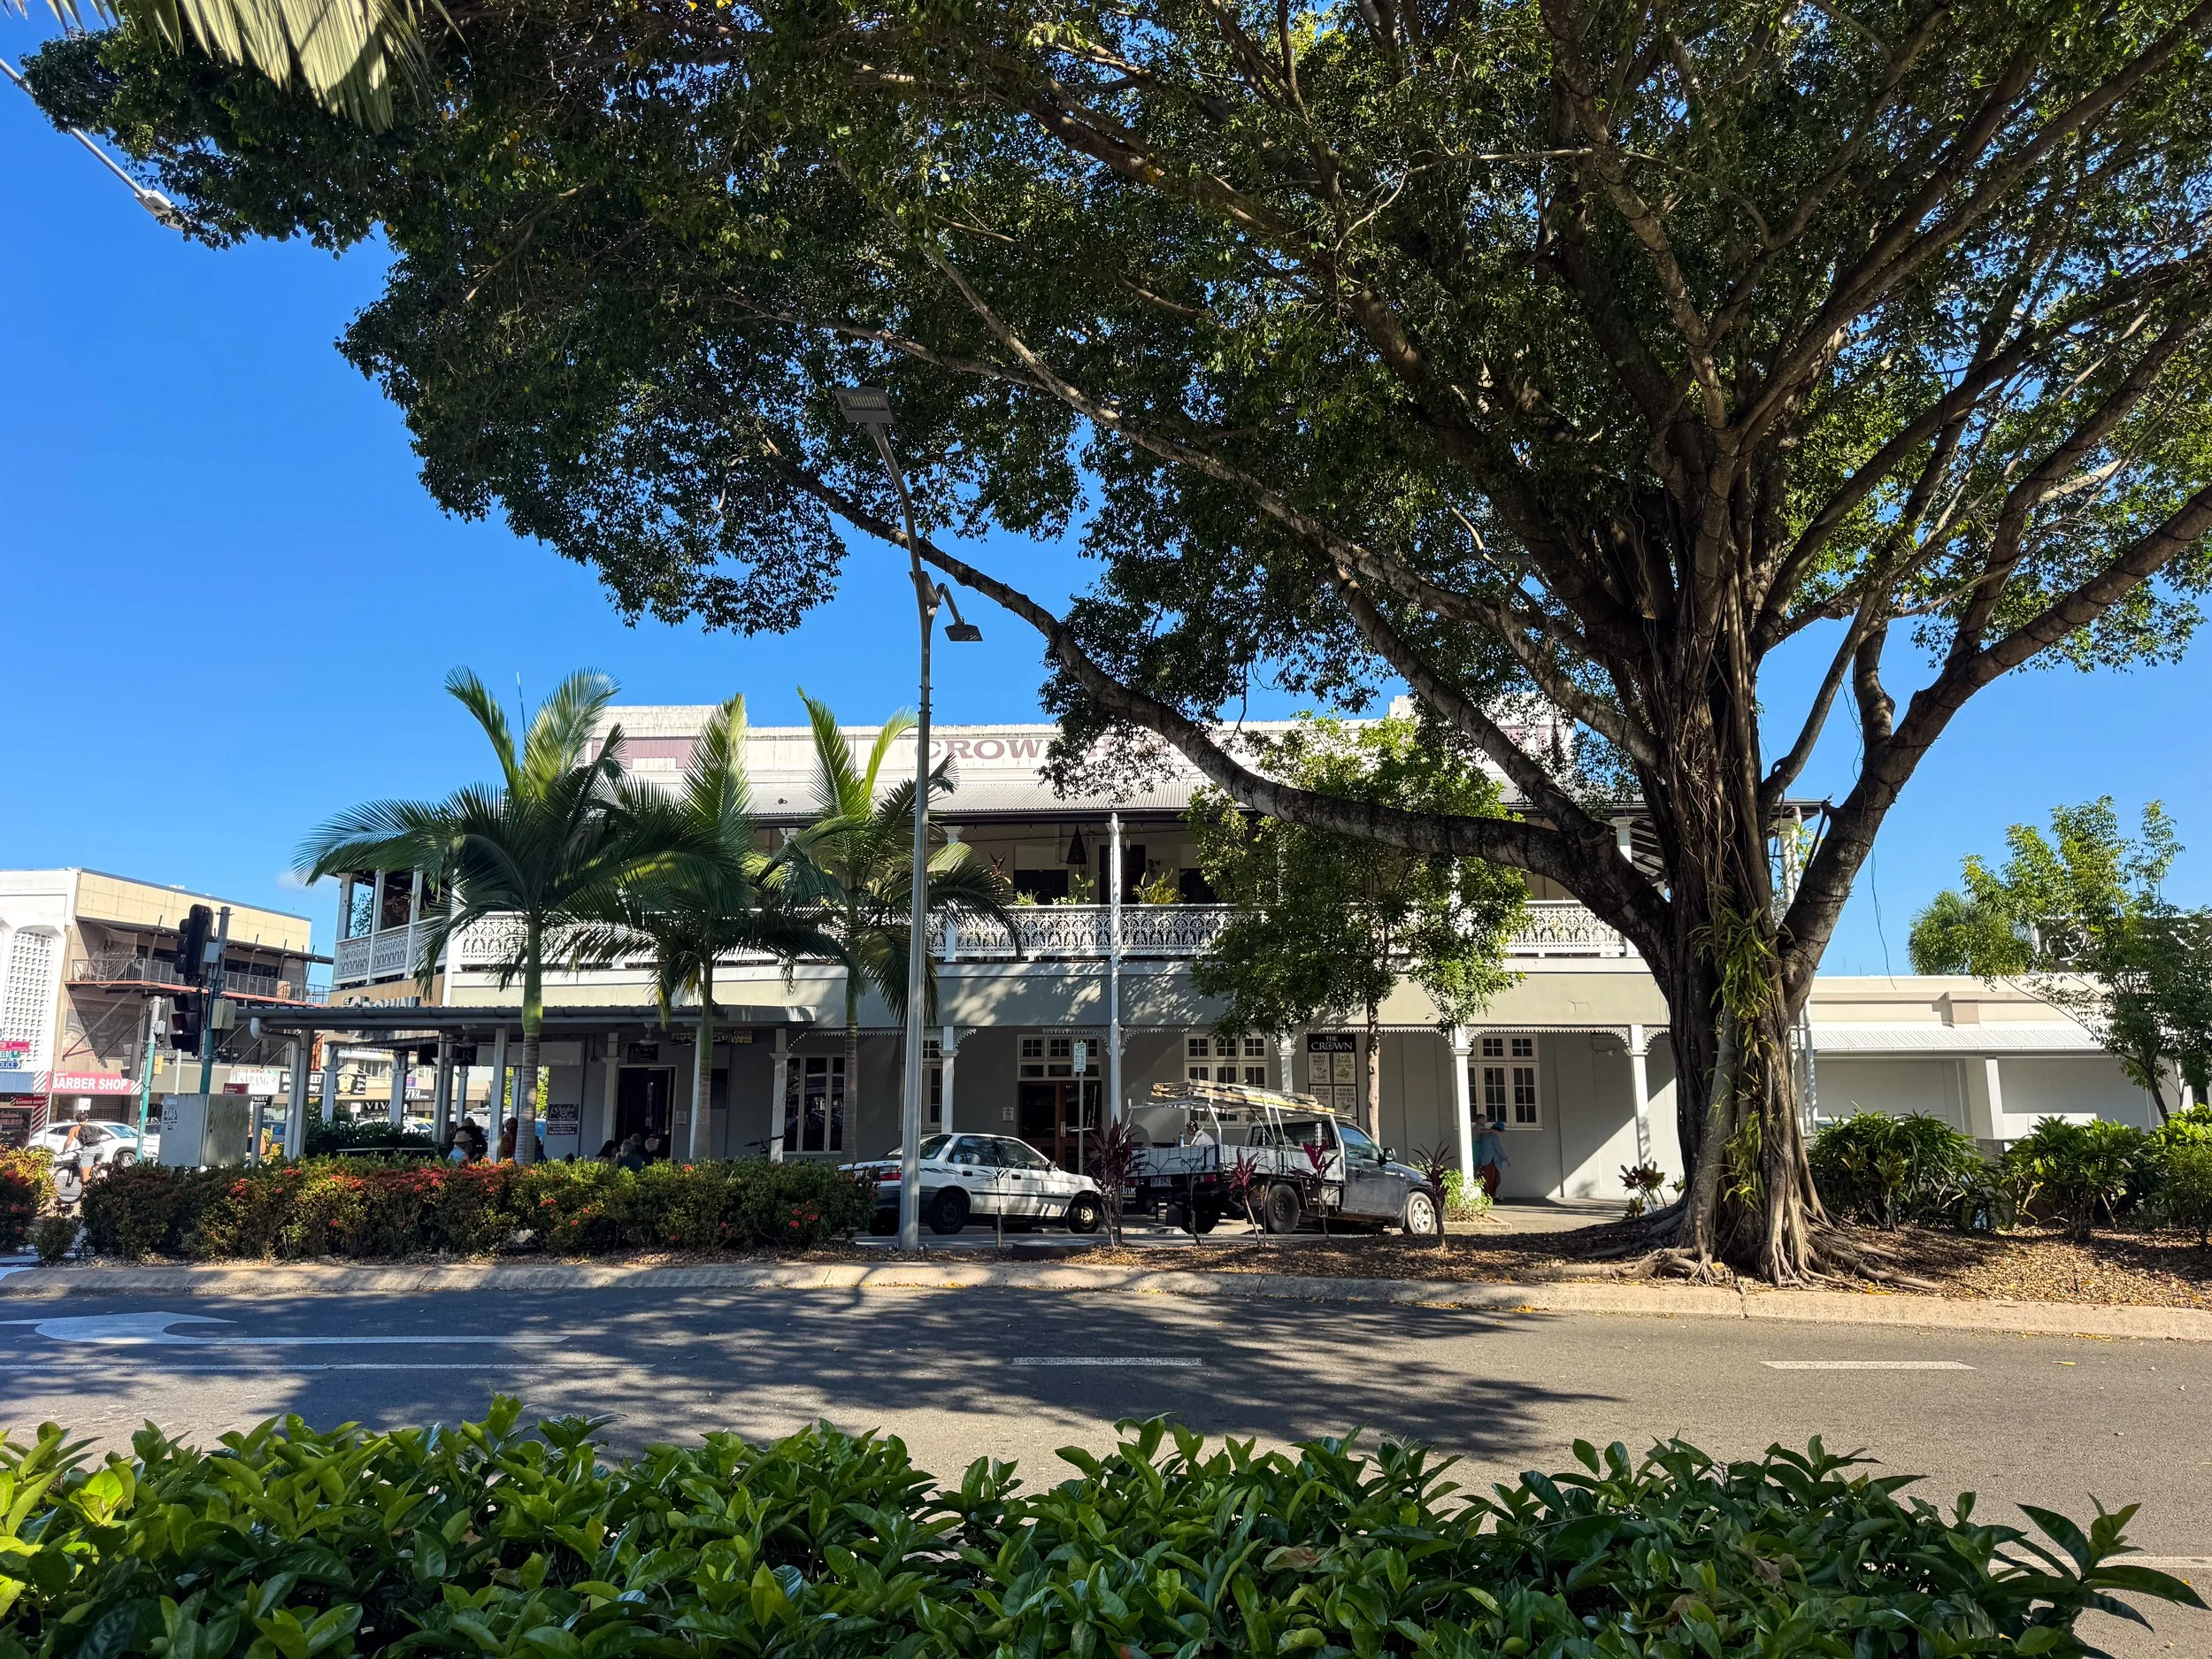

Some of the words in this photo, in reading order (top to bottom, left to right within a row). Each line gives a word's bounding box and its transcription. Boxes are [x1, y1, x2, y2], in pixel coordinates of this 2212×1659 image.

[915, 740, 1055, 760] CROW
[1310, 1041, 1353, 1050] CROWN
[51, 1077, 96, 1089] BARBER
[98, 1078, 127, 1090] SHOP
